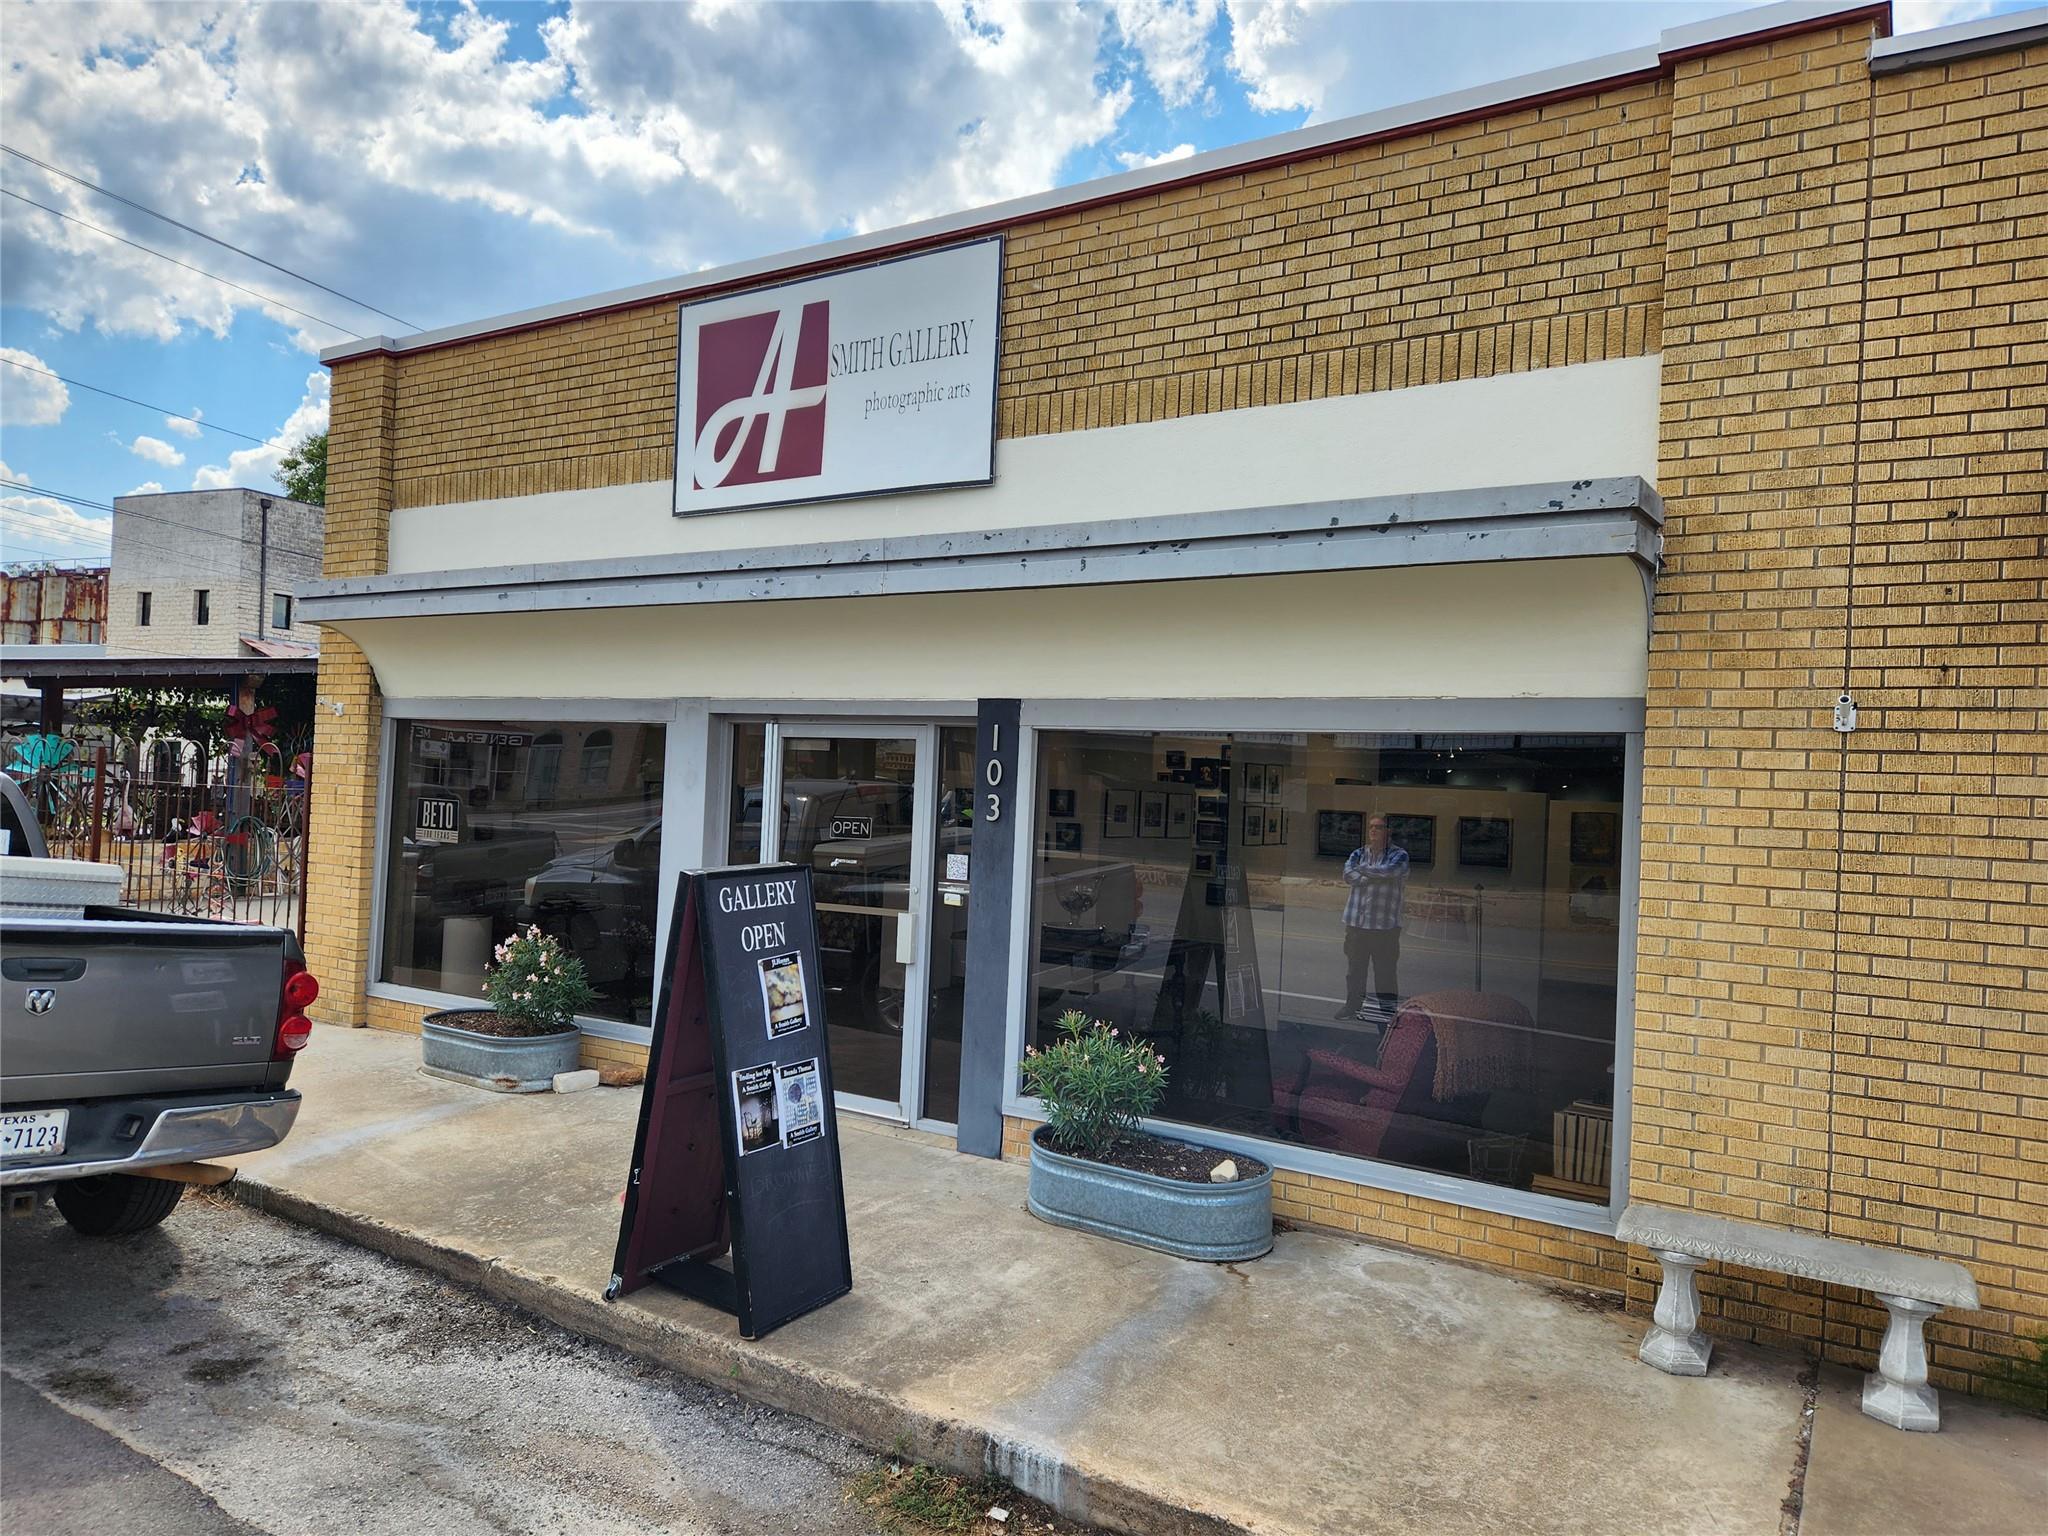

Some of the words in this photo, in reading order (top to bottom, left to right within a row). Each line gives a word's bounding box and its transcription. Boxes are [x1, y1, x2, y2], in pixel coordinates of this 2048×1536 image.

[831, 335, 884, 378] SMITH
[889, 319, 975, 368] GALLERY
[864, 380, 945, 419] photographic
[948, 382, 972, 401] arts
[985, 724, 1003, 822] 103
[422, 800, 454, 829] BETO
[832, 821, 870, 835] OPEN
[719, 879, 798, 914] GALLERY
[741, 921, 787, 952] OPEN
